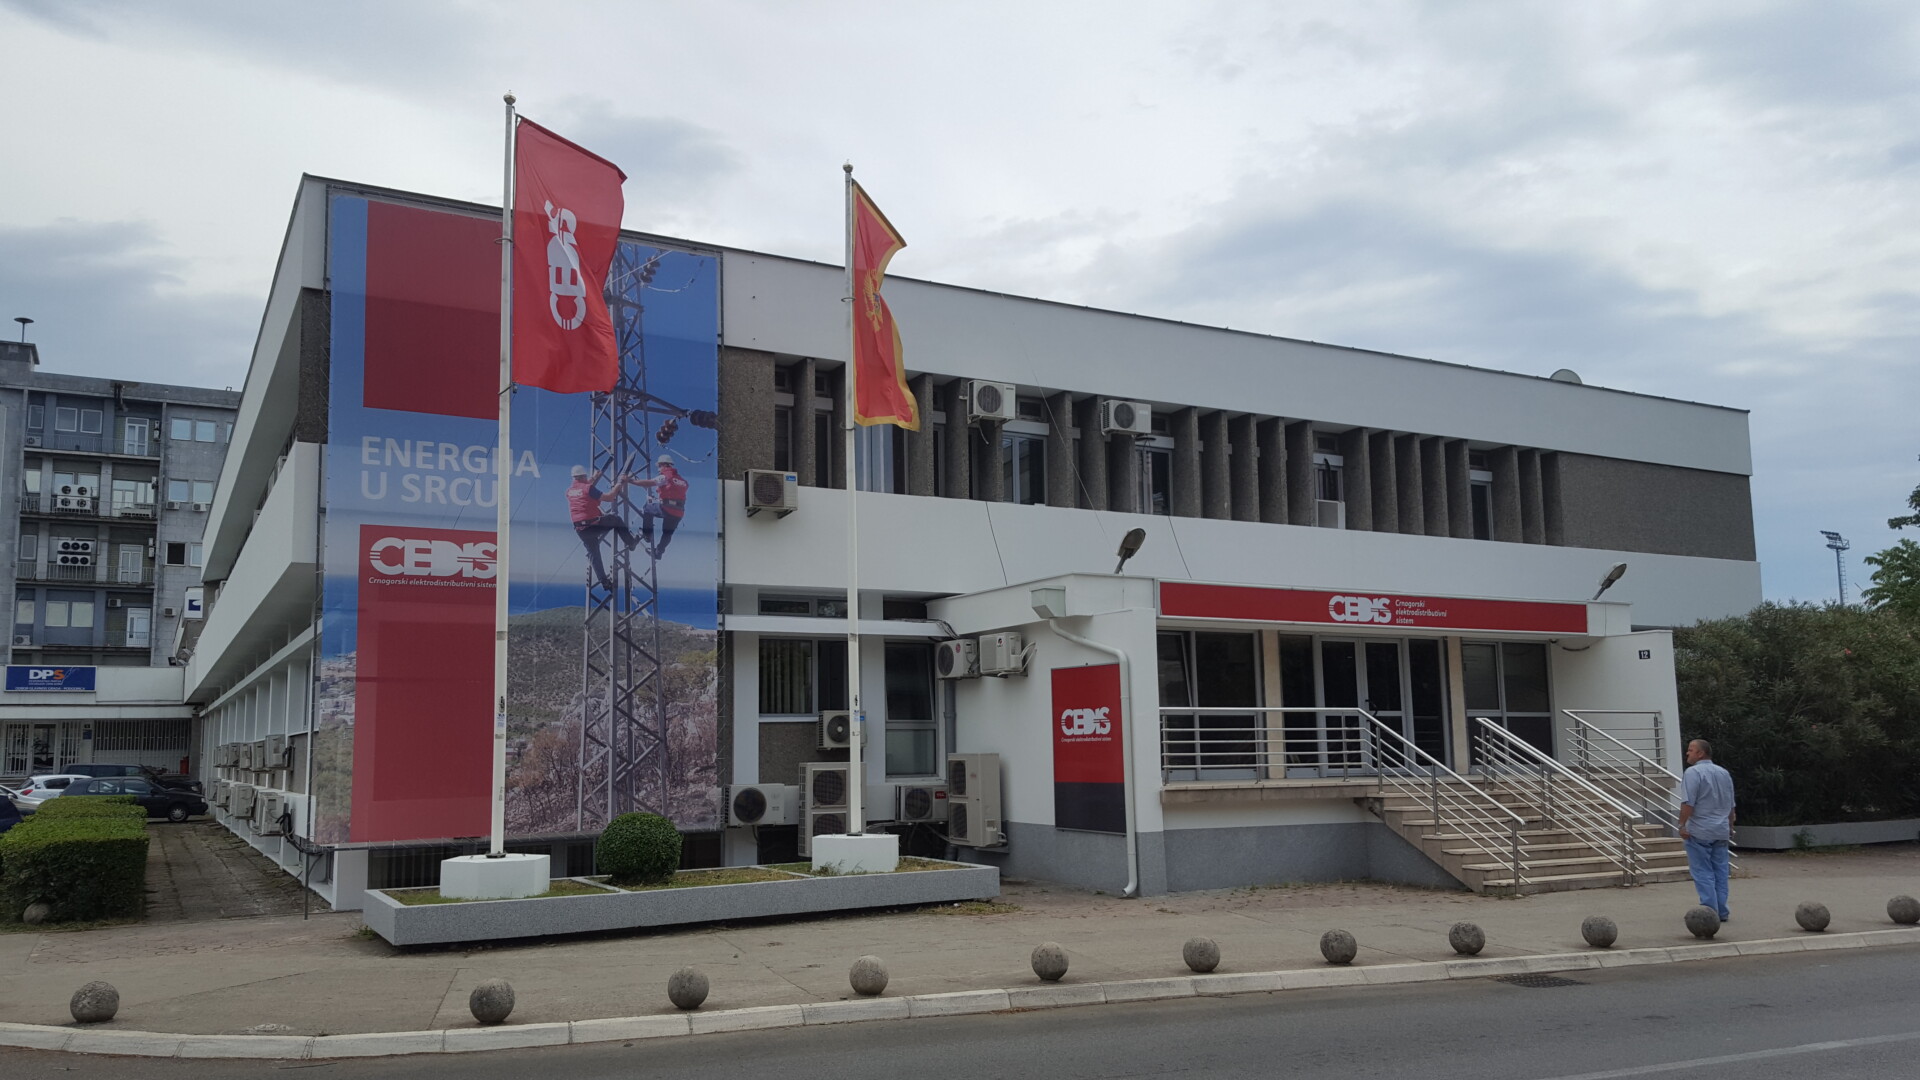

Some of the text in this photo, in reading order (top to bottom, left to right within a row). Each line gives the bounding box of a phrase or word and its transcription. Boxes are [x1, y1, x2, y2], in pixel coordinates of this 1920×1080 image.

[544, 200, 586, 330] CEDIS
[361, 470, 387, 500] U
[401, 473, 499, 508] SRCU
[369, 537, 497, 579] CEDIS
[368, 577, 408, 586] Crnogorski
[409, 578, 476, 588] elektrodistributivni
[1328, 595, 1392, 624] CEDIS
[1395, 599, 1425, 608] Crnogorski
[1395, 608, 1447, 617] elektrodistributivni
[1641, 651, 1648, 659] 12
[29, 669, 65, 680] DPS
[1061, 706, 1111, 736] CEDIS
